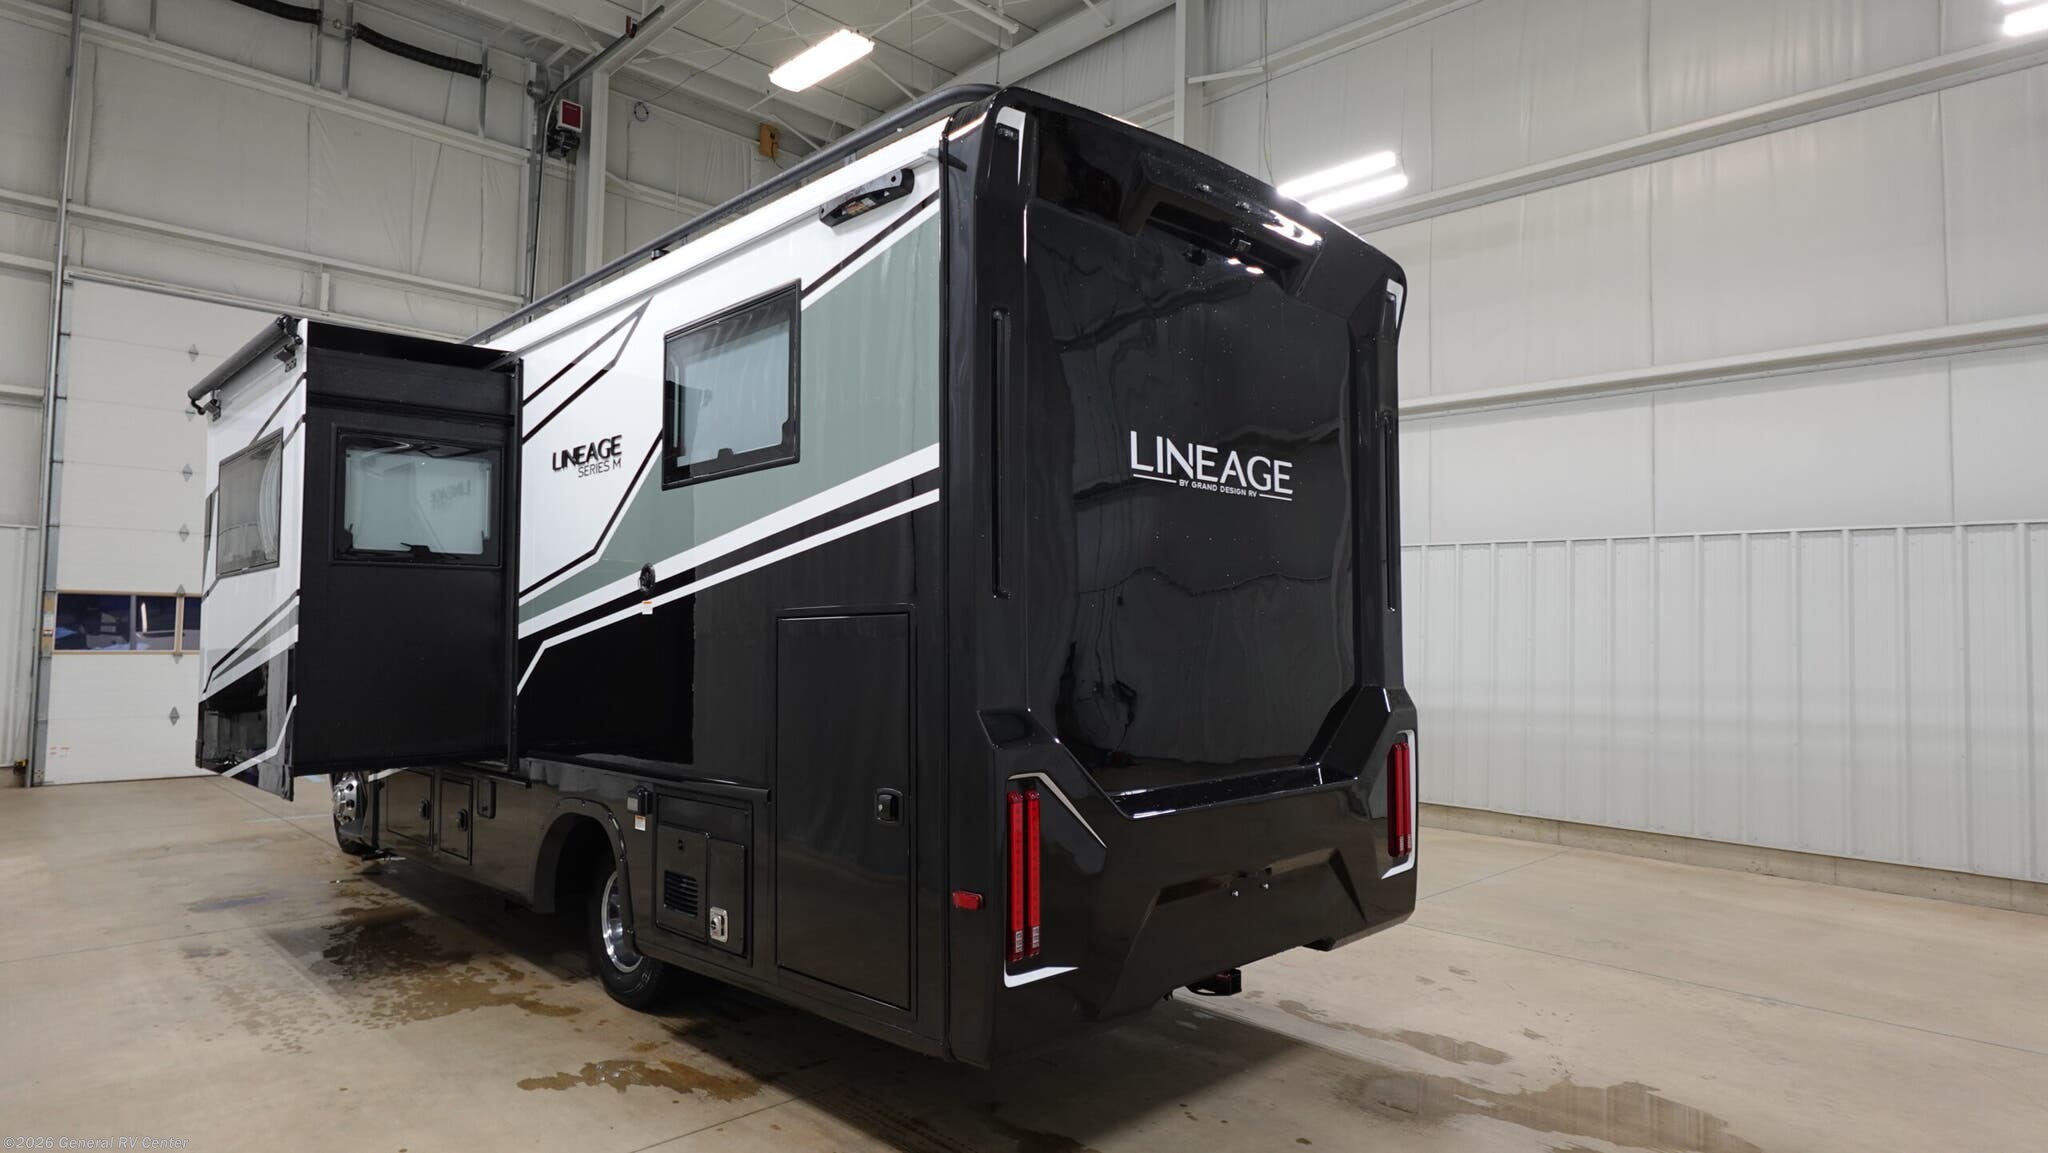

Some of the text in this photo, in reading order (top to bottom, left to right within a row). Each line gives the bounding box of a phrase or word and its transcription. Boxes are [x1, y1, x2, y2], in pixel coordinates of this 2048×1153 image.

[552, 434, 622, 472] LINEAGE
[1130, 430, 1293, 495] LINEAGE
[578, 458, 622, 478] SERIES M
[1178, 479, 1258, 498] BY GRAND DESIGN RV
